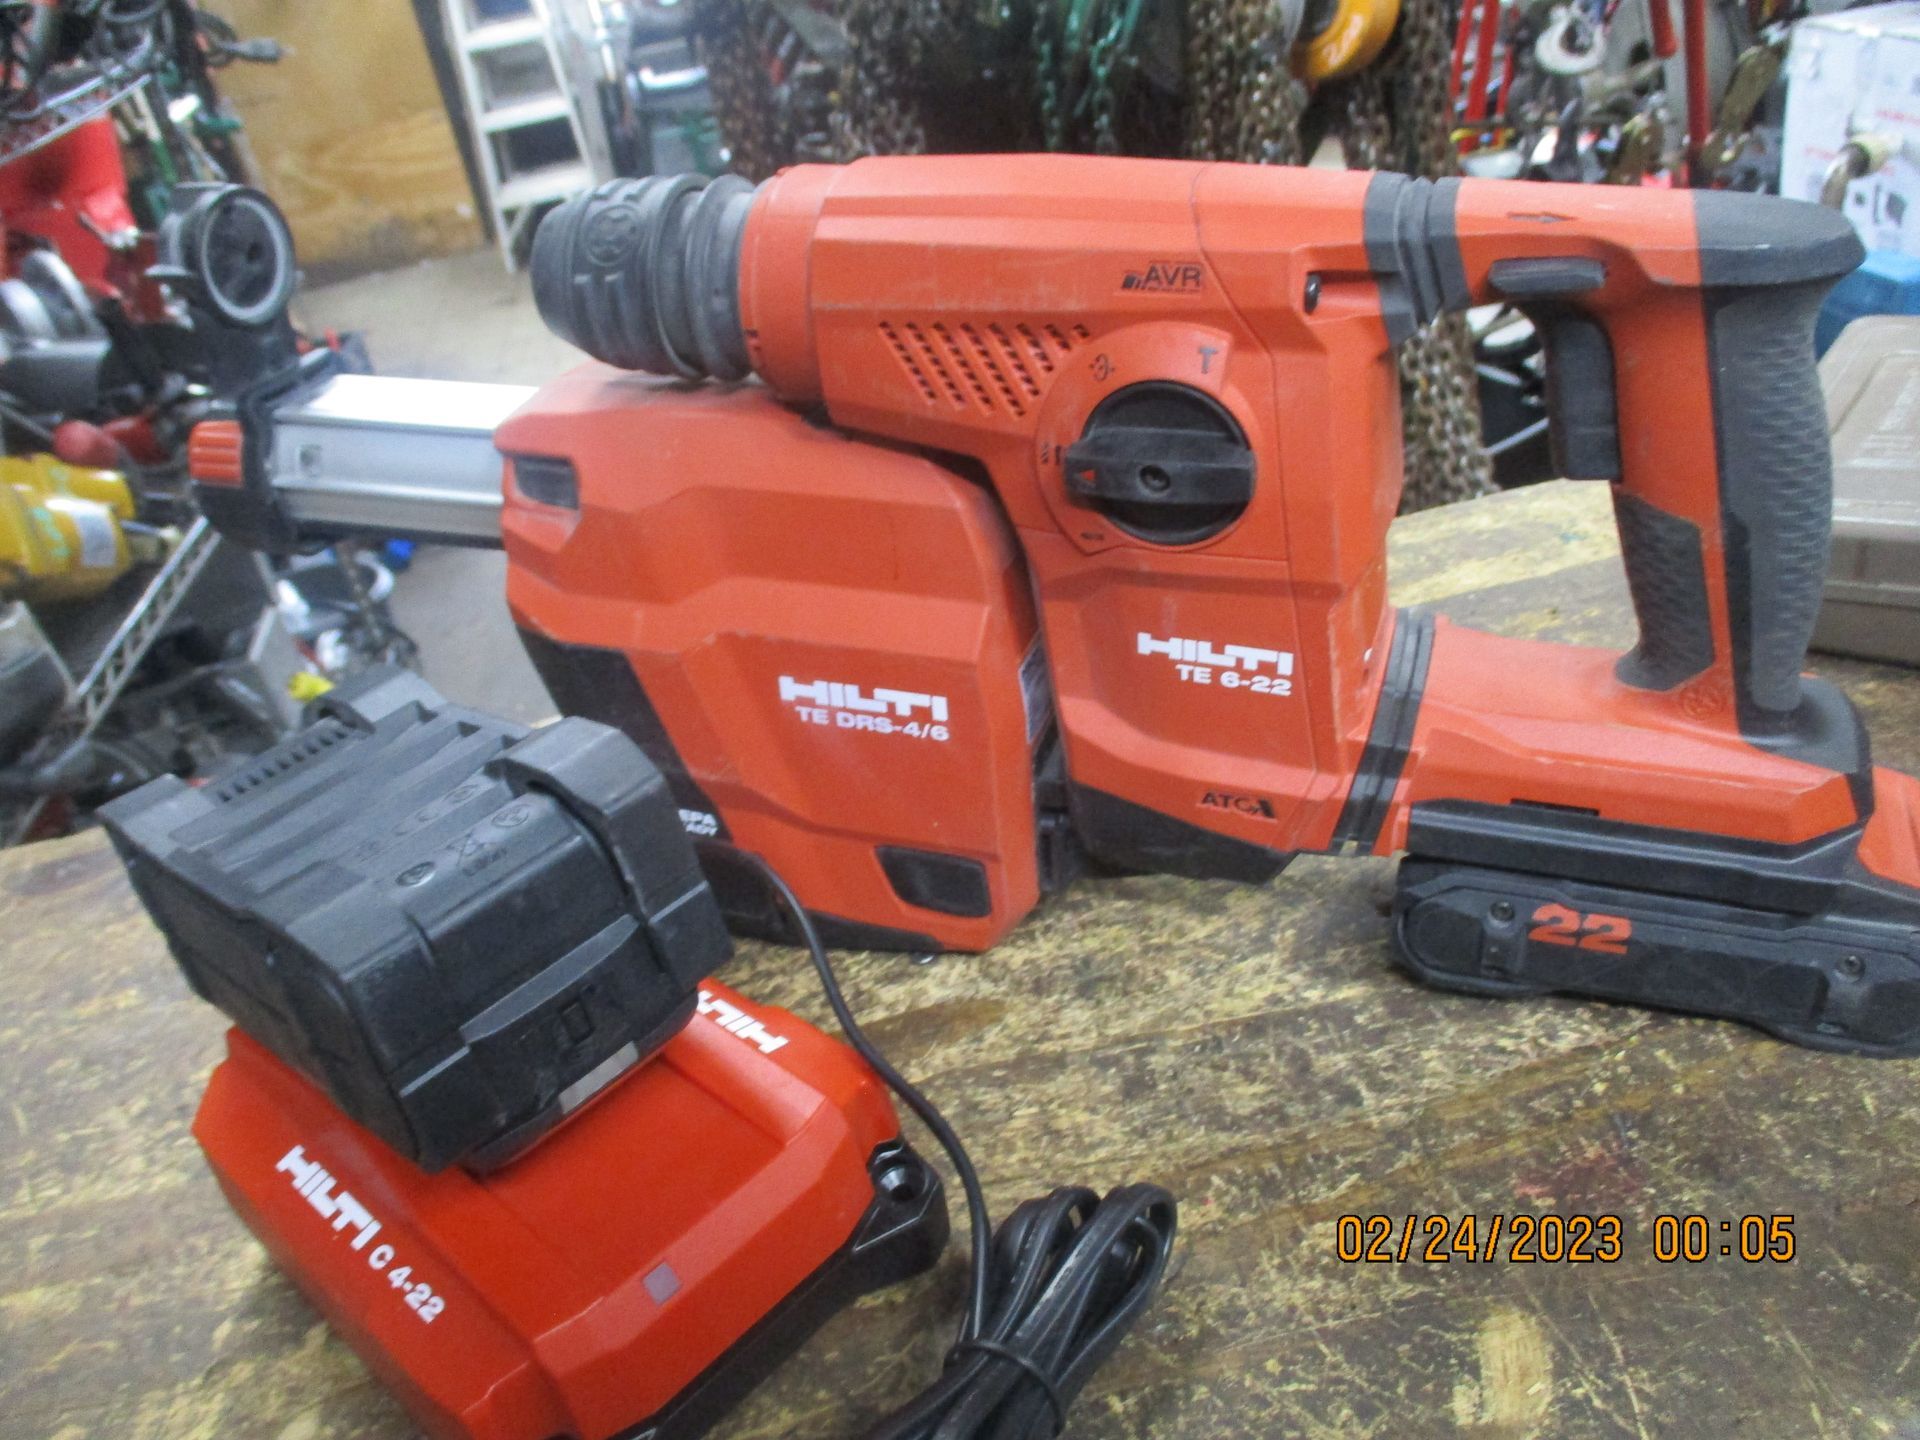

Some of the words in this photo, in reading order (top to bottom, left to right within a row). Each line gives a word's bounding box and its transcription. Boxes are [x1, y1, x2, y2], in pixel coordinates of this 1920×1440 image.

[1144, 264, 1201, 288] AVR
[1137, 632, 1294, 676] HILTI
[778, 675, 949, 722] HILTI
[1175, 664, 1212, 685] TE
[1220, 671, 1292, 697] 6-22
[795, 705, 830, 725] TE
[835, 711, 950, 742] DRS-4/6
[1528, 902, 1633, 955] 22
[275, 1144, 383, 1252] HILTI
[368, 1244, 395, 1270] C
[387, 1265, 445, 1325] 4-22
